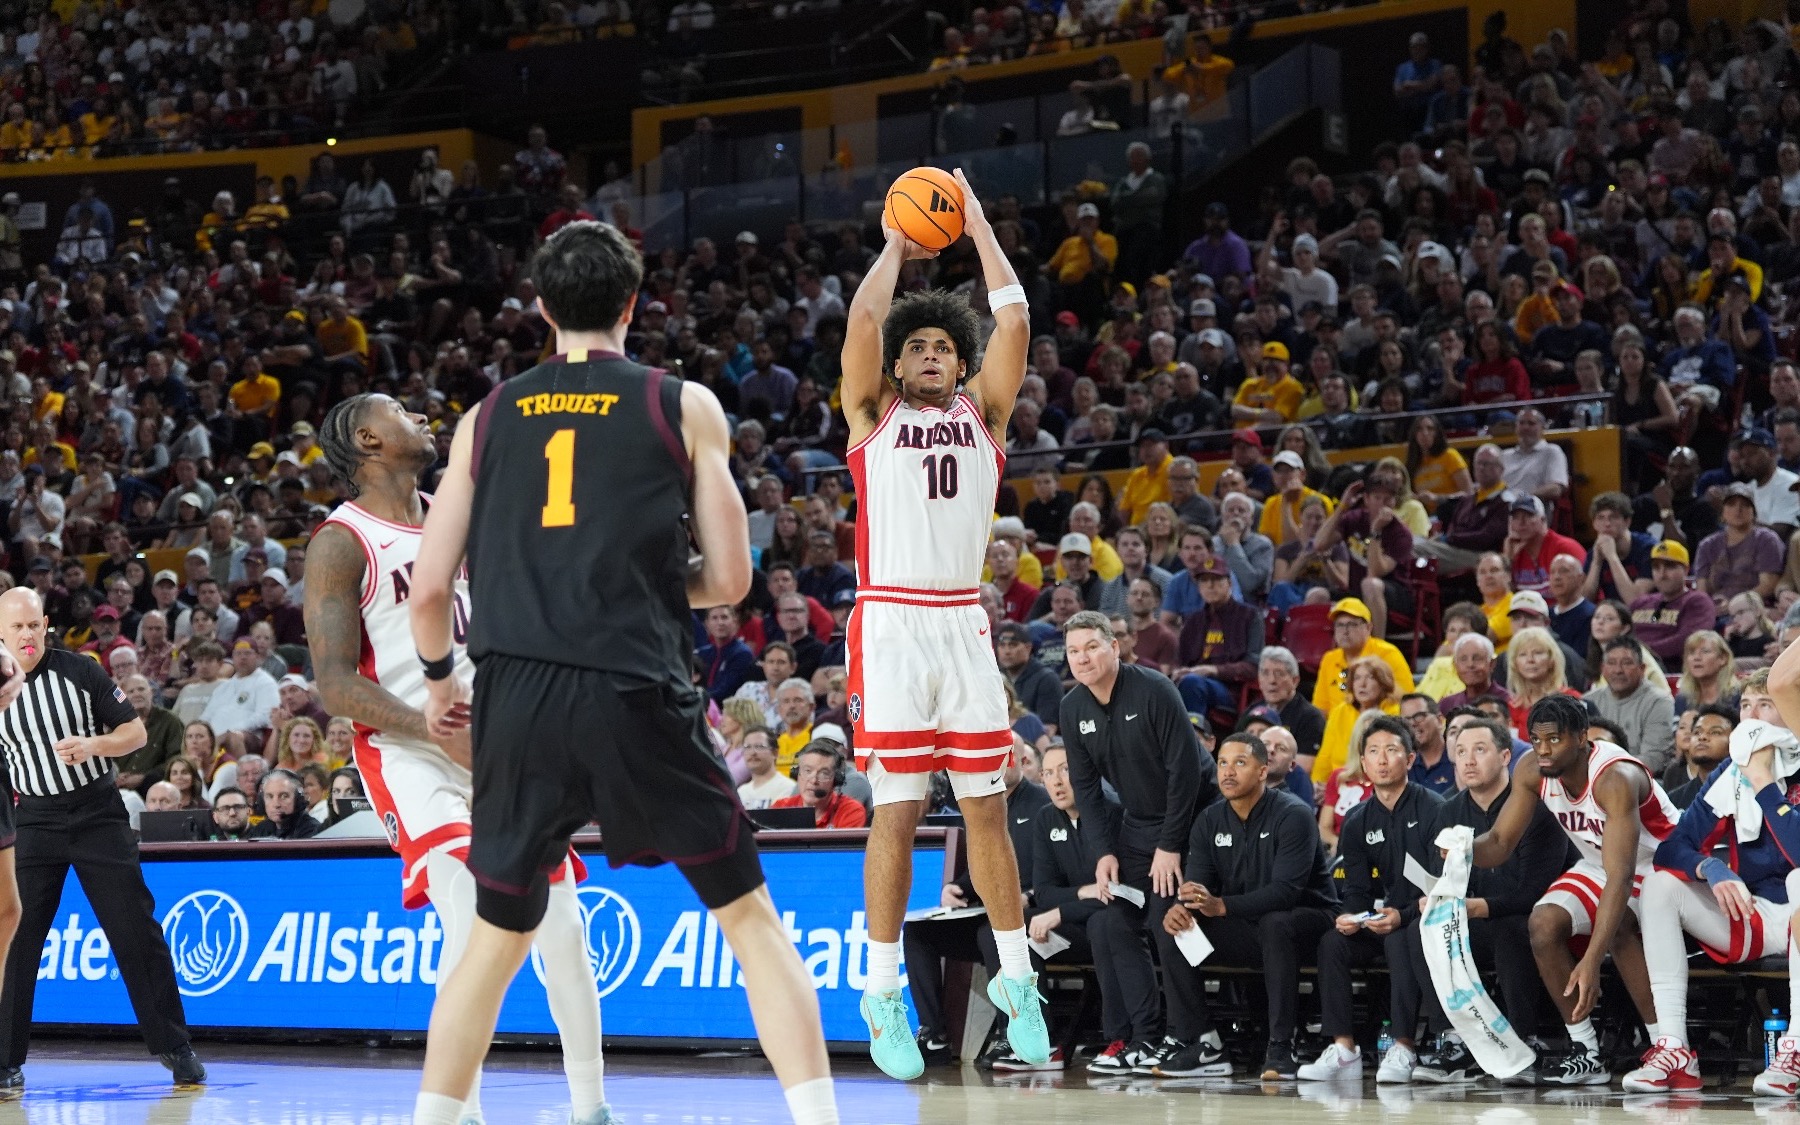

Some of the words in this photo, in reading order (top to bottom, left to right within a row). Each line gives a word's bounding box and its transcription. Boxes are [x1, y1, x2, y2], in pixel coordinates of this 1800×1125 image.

[516, 394, 619, 416] TROUET
[894, 421, 977, 449] ARIZONA
[542, 428, 576, 527] 1
[922, 453, 958, 500] 10
[248, 911, 441, 984] Allstat
